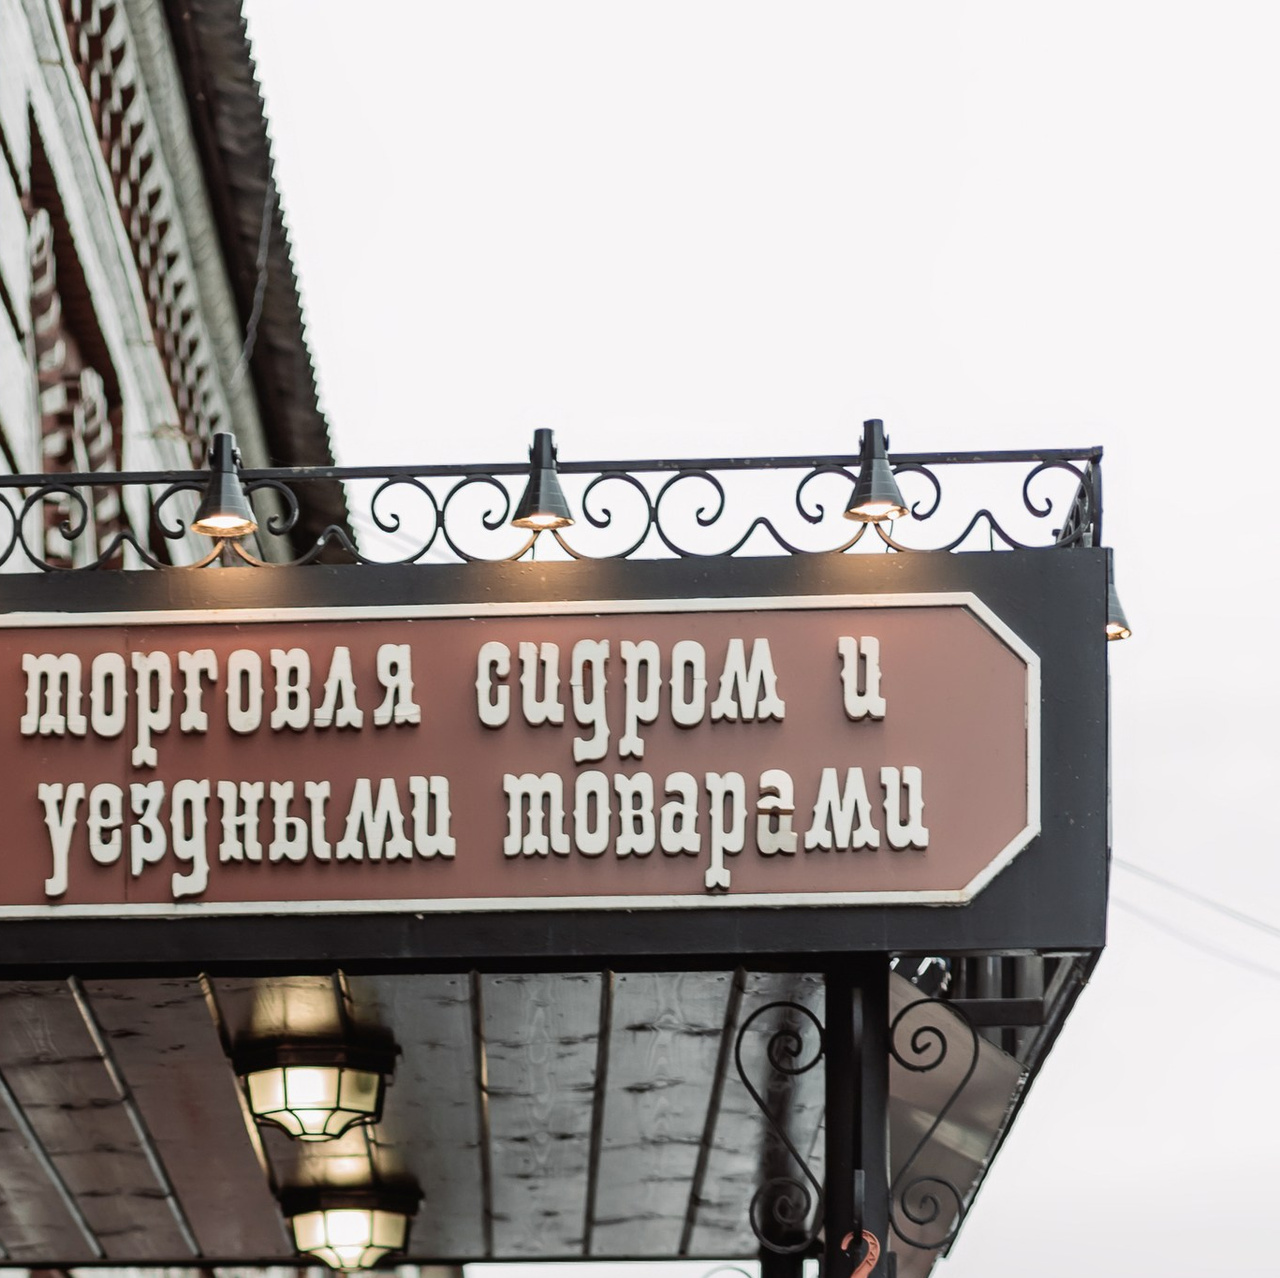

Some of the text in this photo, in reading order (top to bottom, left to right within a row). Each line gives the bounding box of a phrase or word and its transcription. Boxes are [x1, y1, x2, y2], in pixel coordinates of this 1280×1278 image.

[20, 644, 421, 768] торговля
[475, 639, 786, 764] сидром
[838, 636, 887, 721] и
[38, 776, 456, 898] уездными
[503, 766, 929, 890] товарами
